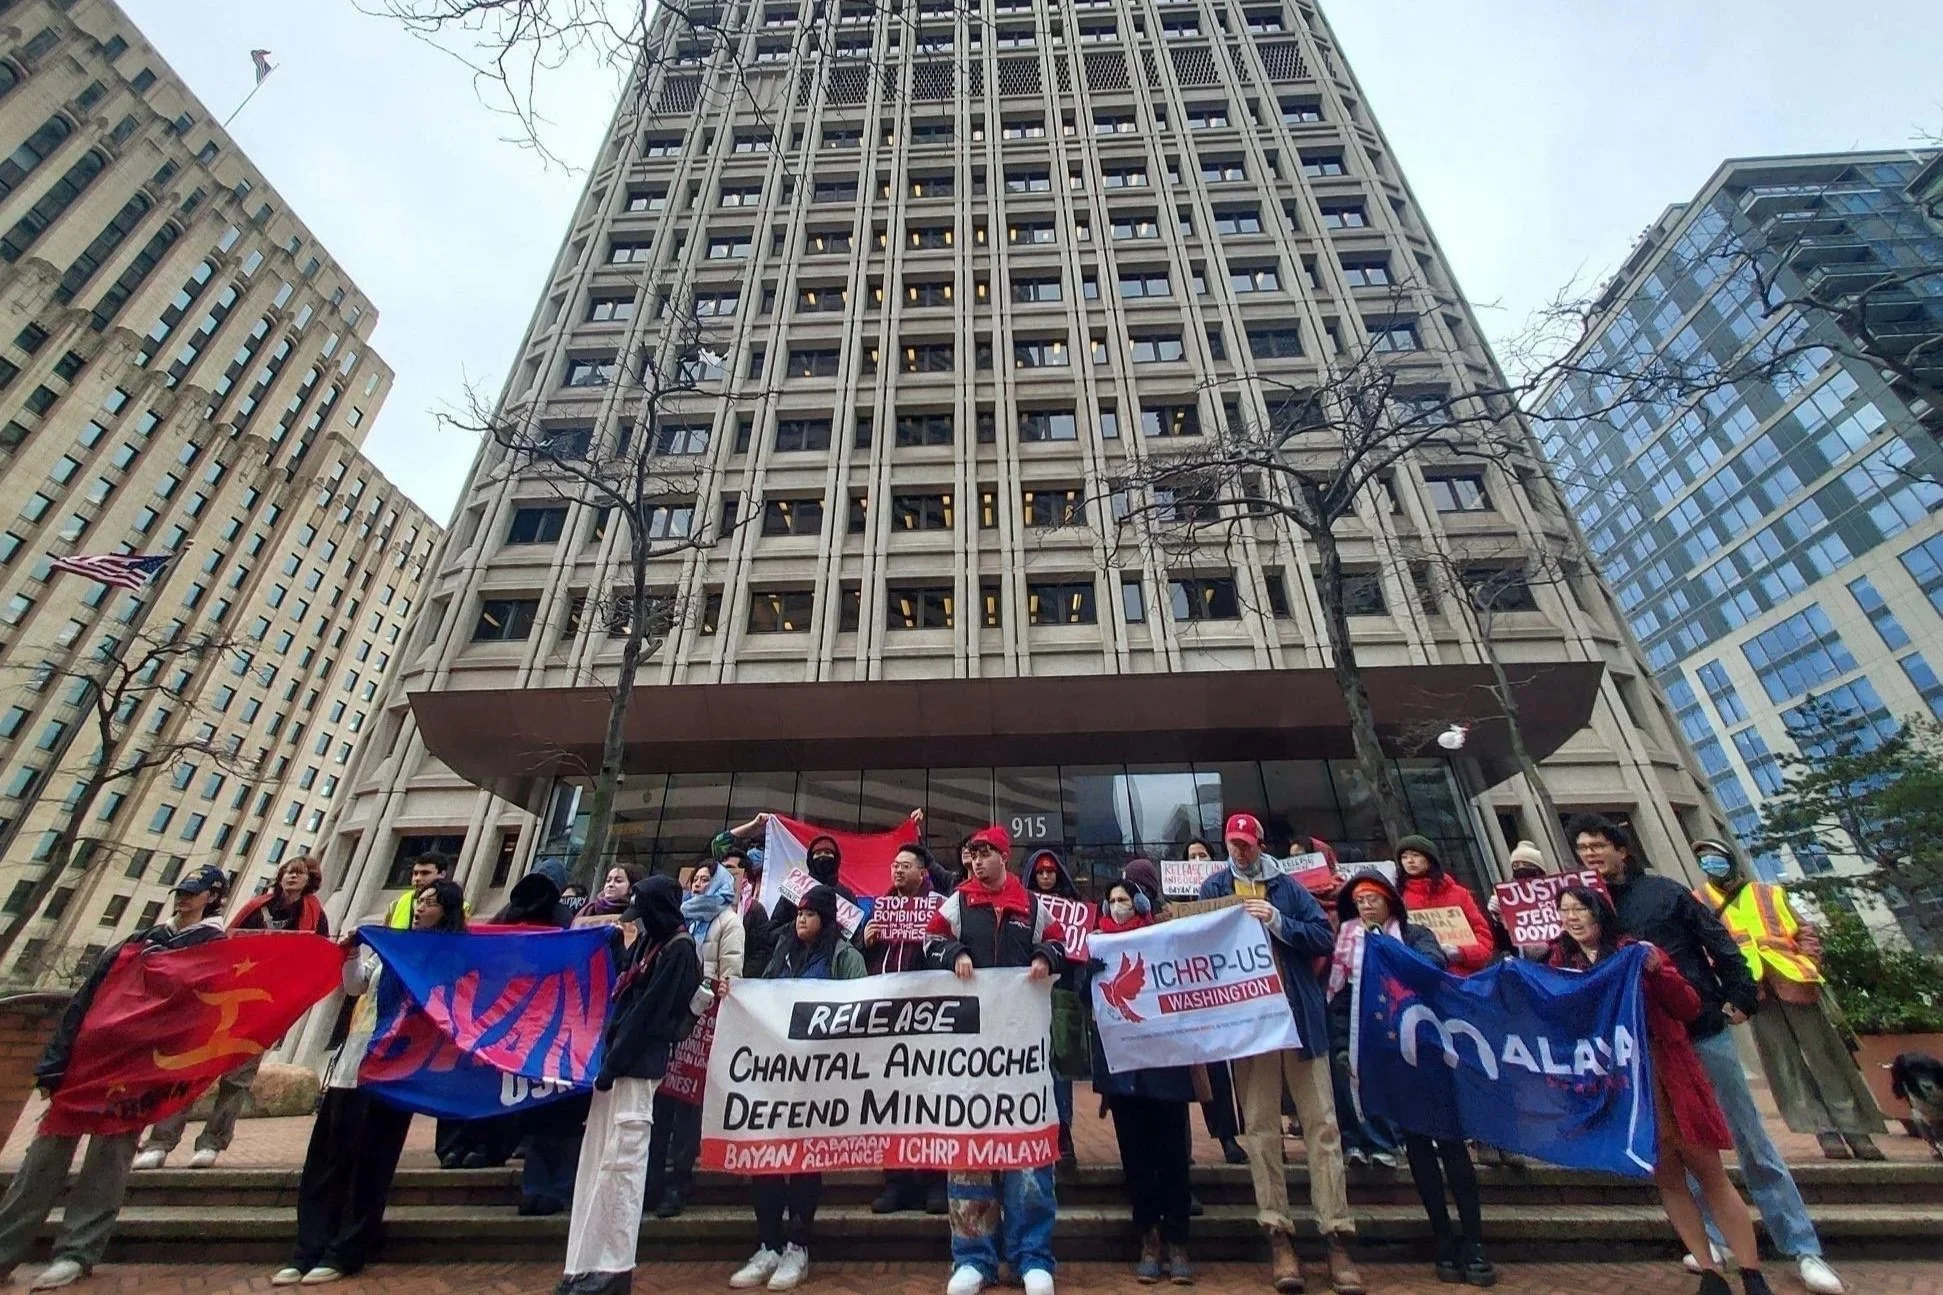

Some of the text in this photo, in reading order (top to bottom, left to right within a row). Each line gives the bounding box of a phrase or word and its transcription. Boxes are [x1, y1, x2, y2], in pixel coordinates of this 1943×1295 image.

[1012, 816, 1047, 838] 915
[1496, 870, 1598, 906] JUSTICE
[874, 895, 937, 909] STOP THE
[874, 909, 935, 922] BOMBINGS
[900, 922, 914, 930] THE
[1514, 923, 1562, 942] DOYD
[1151, 943, 1273, 989] ICHRP-US
[1168, 979, 1271, 1012] WASHINGTON
[807, 1000, 962, 1035] RELEASE
[729, 1045, 870, 1083] CHANTAL
[883, 1036, 1047, 1079] ANICOCHE!
[722, 1085, 1048, 1131] DEFEND MINDORO!
[723, 1134, 1053, 1171] BAYAN ICHRP MALAYA
[802, 1136, 891, 1151] KABATAAN
[801, 1150, 885, 1170] ALLIANCE
